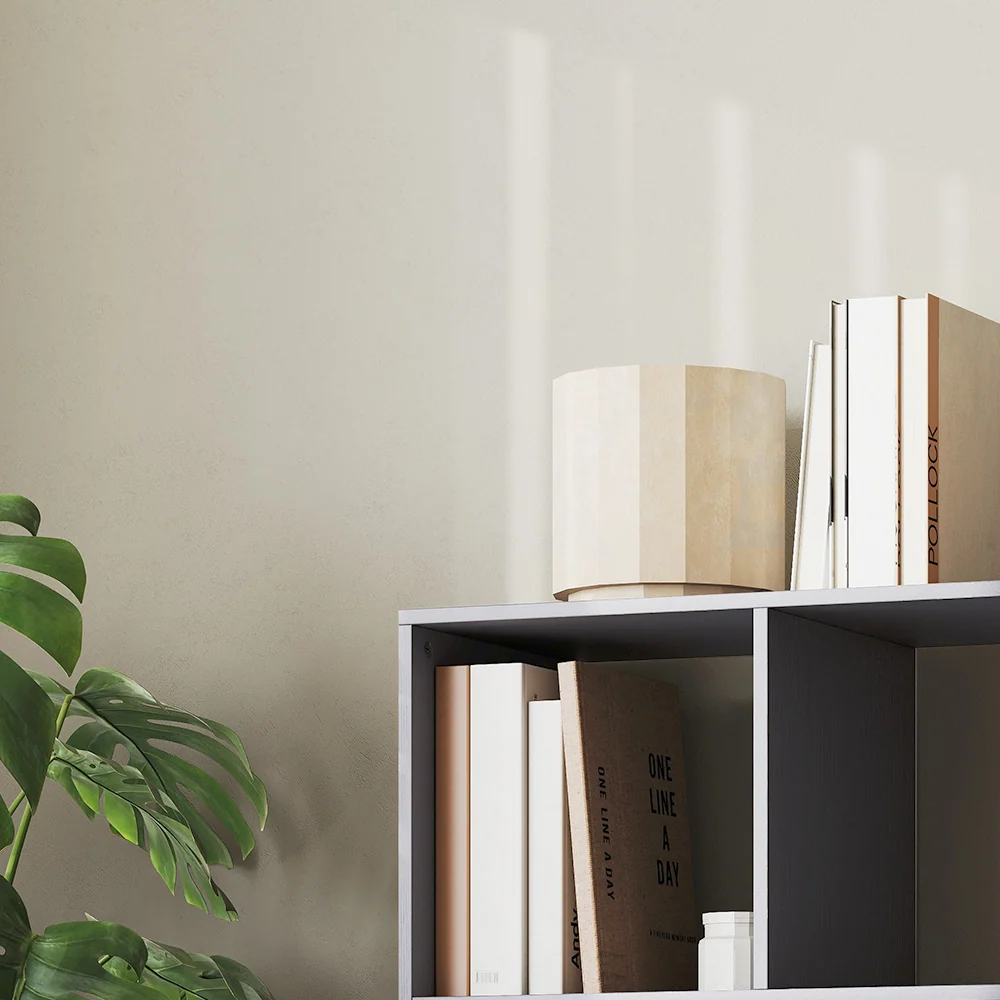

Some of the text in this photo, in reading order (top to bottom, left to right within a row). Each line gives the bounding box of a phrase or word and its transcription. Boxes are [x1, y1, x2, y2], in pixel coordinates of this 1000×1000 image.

[927, 425, 939, 567] POLLOCK
[648, 752, 673, 782] ONE
[649, 787, 677, 818] LINE
[597, 766, 616, 900] ONE LINE A DAY
[662, 825, 670, 851] A
[656, 859, 680, 888] DAY
